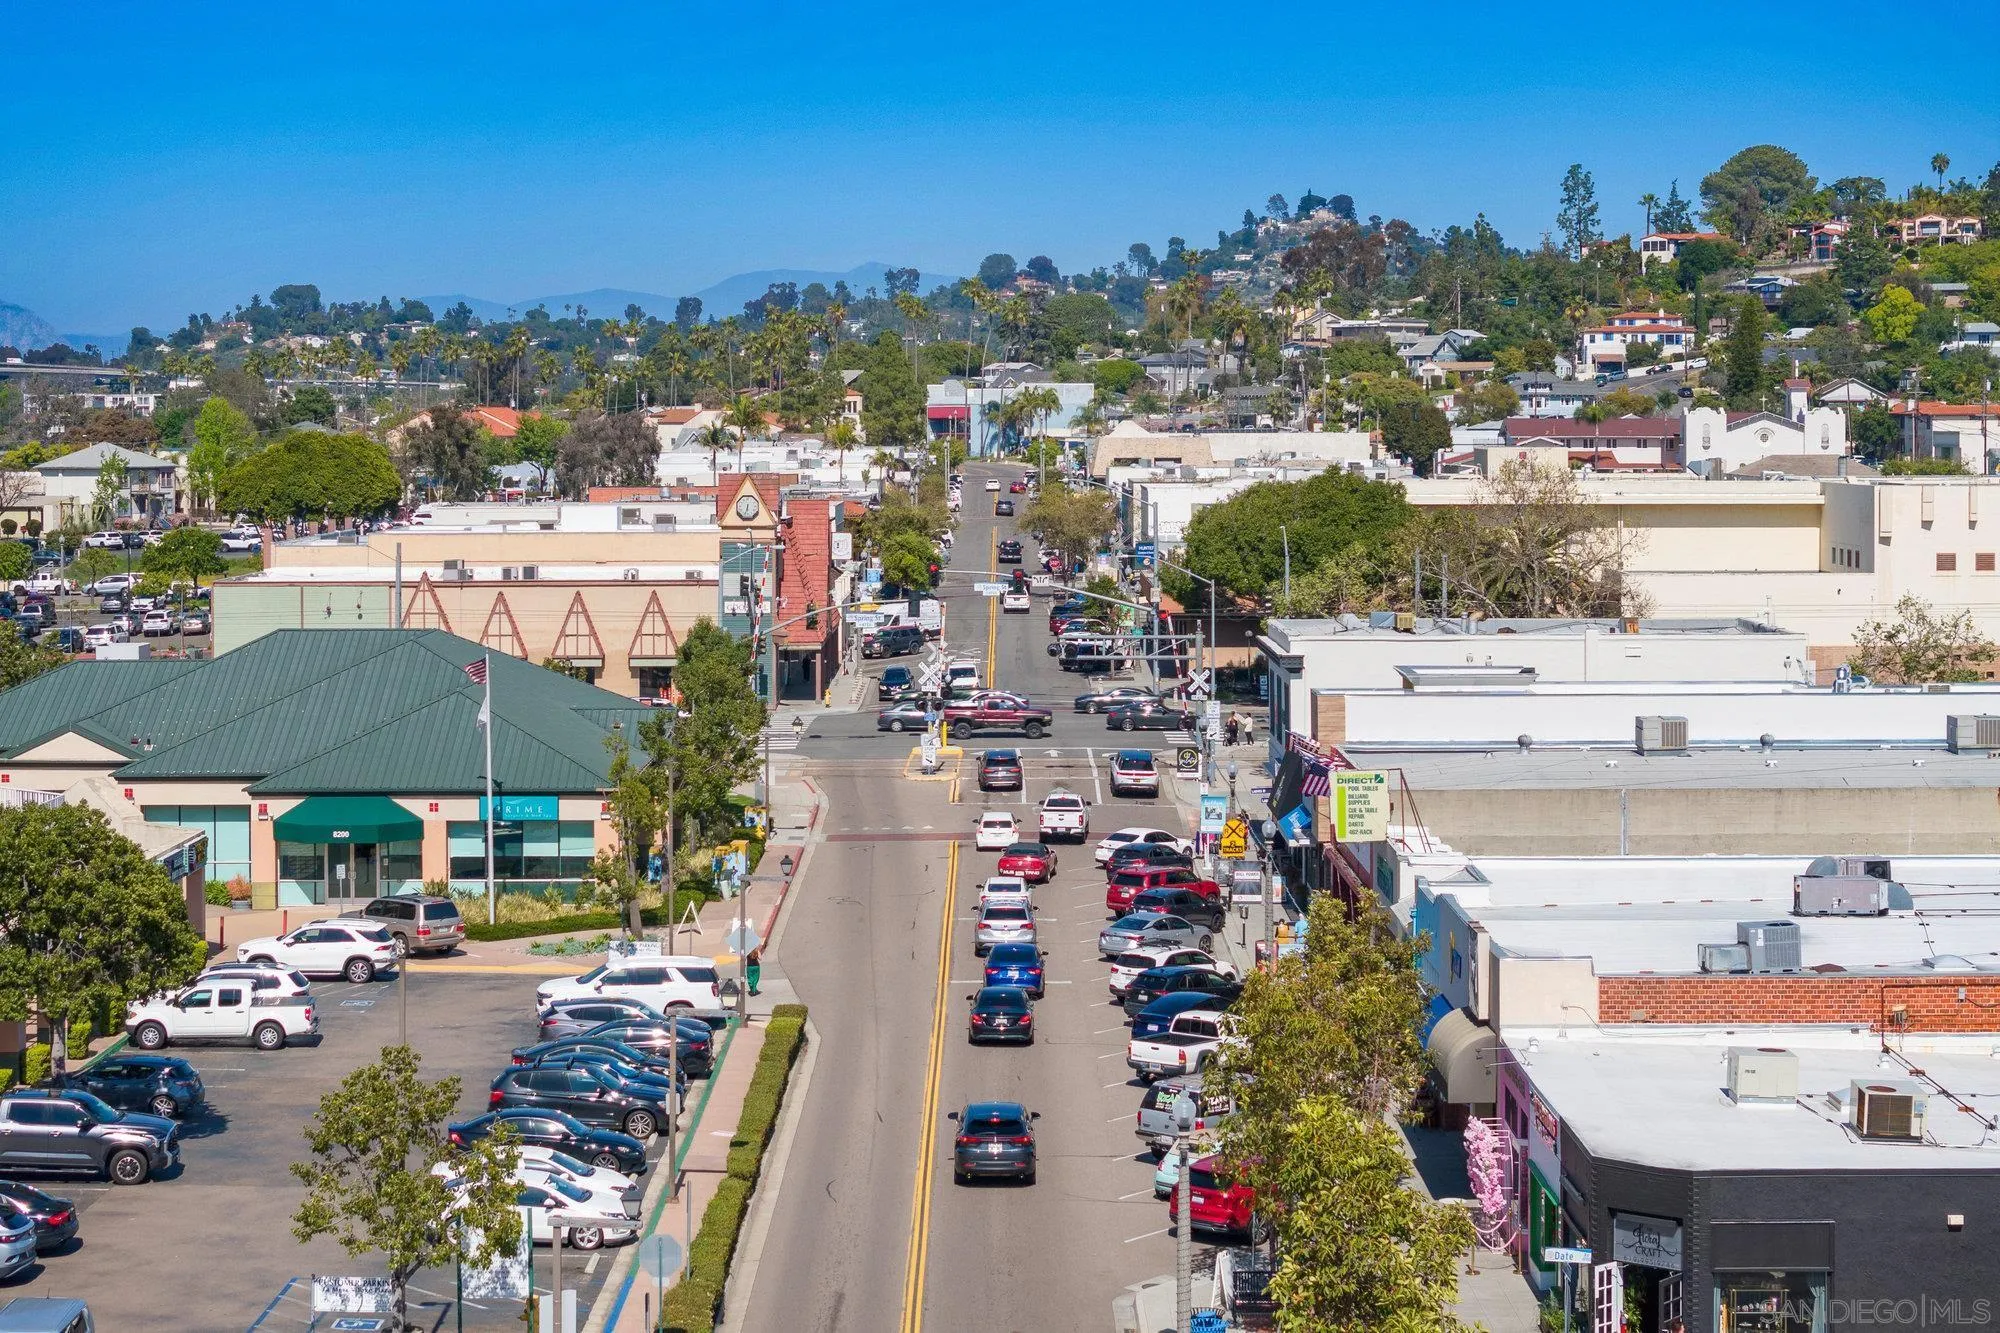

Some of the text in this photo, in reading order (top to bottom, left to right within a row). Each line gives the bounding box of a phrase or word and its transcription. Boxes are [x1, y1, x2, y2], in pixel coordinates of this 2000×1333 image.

[982, 584, 1000, 592] Spring
[854, 614, 874, 623] Spring
[1554, 1251, 1574, 1261] Date
[1635, 1245, 1662, 1258] CRAFT
[363, 1279, 391, 1287] PARKIN
